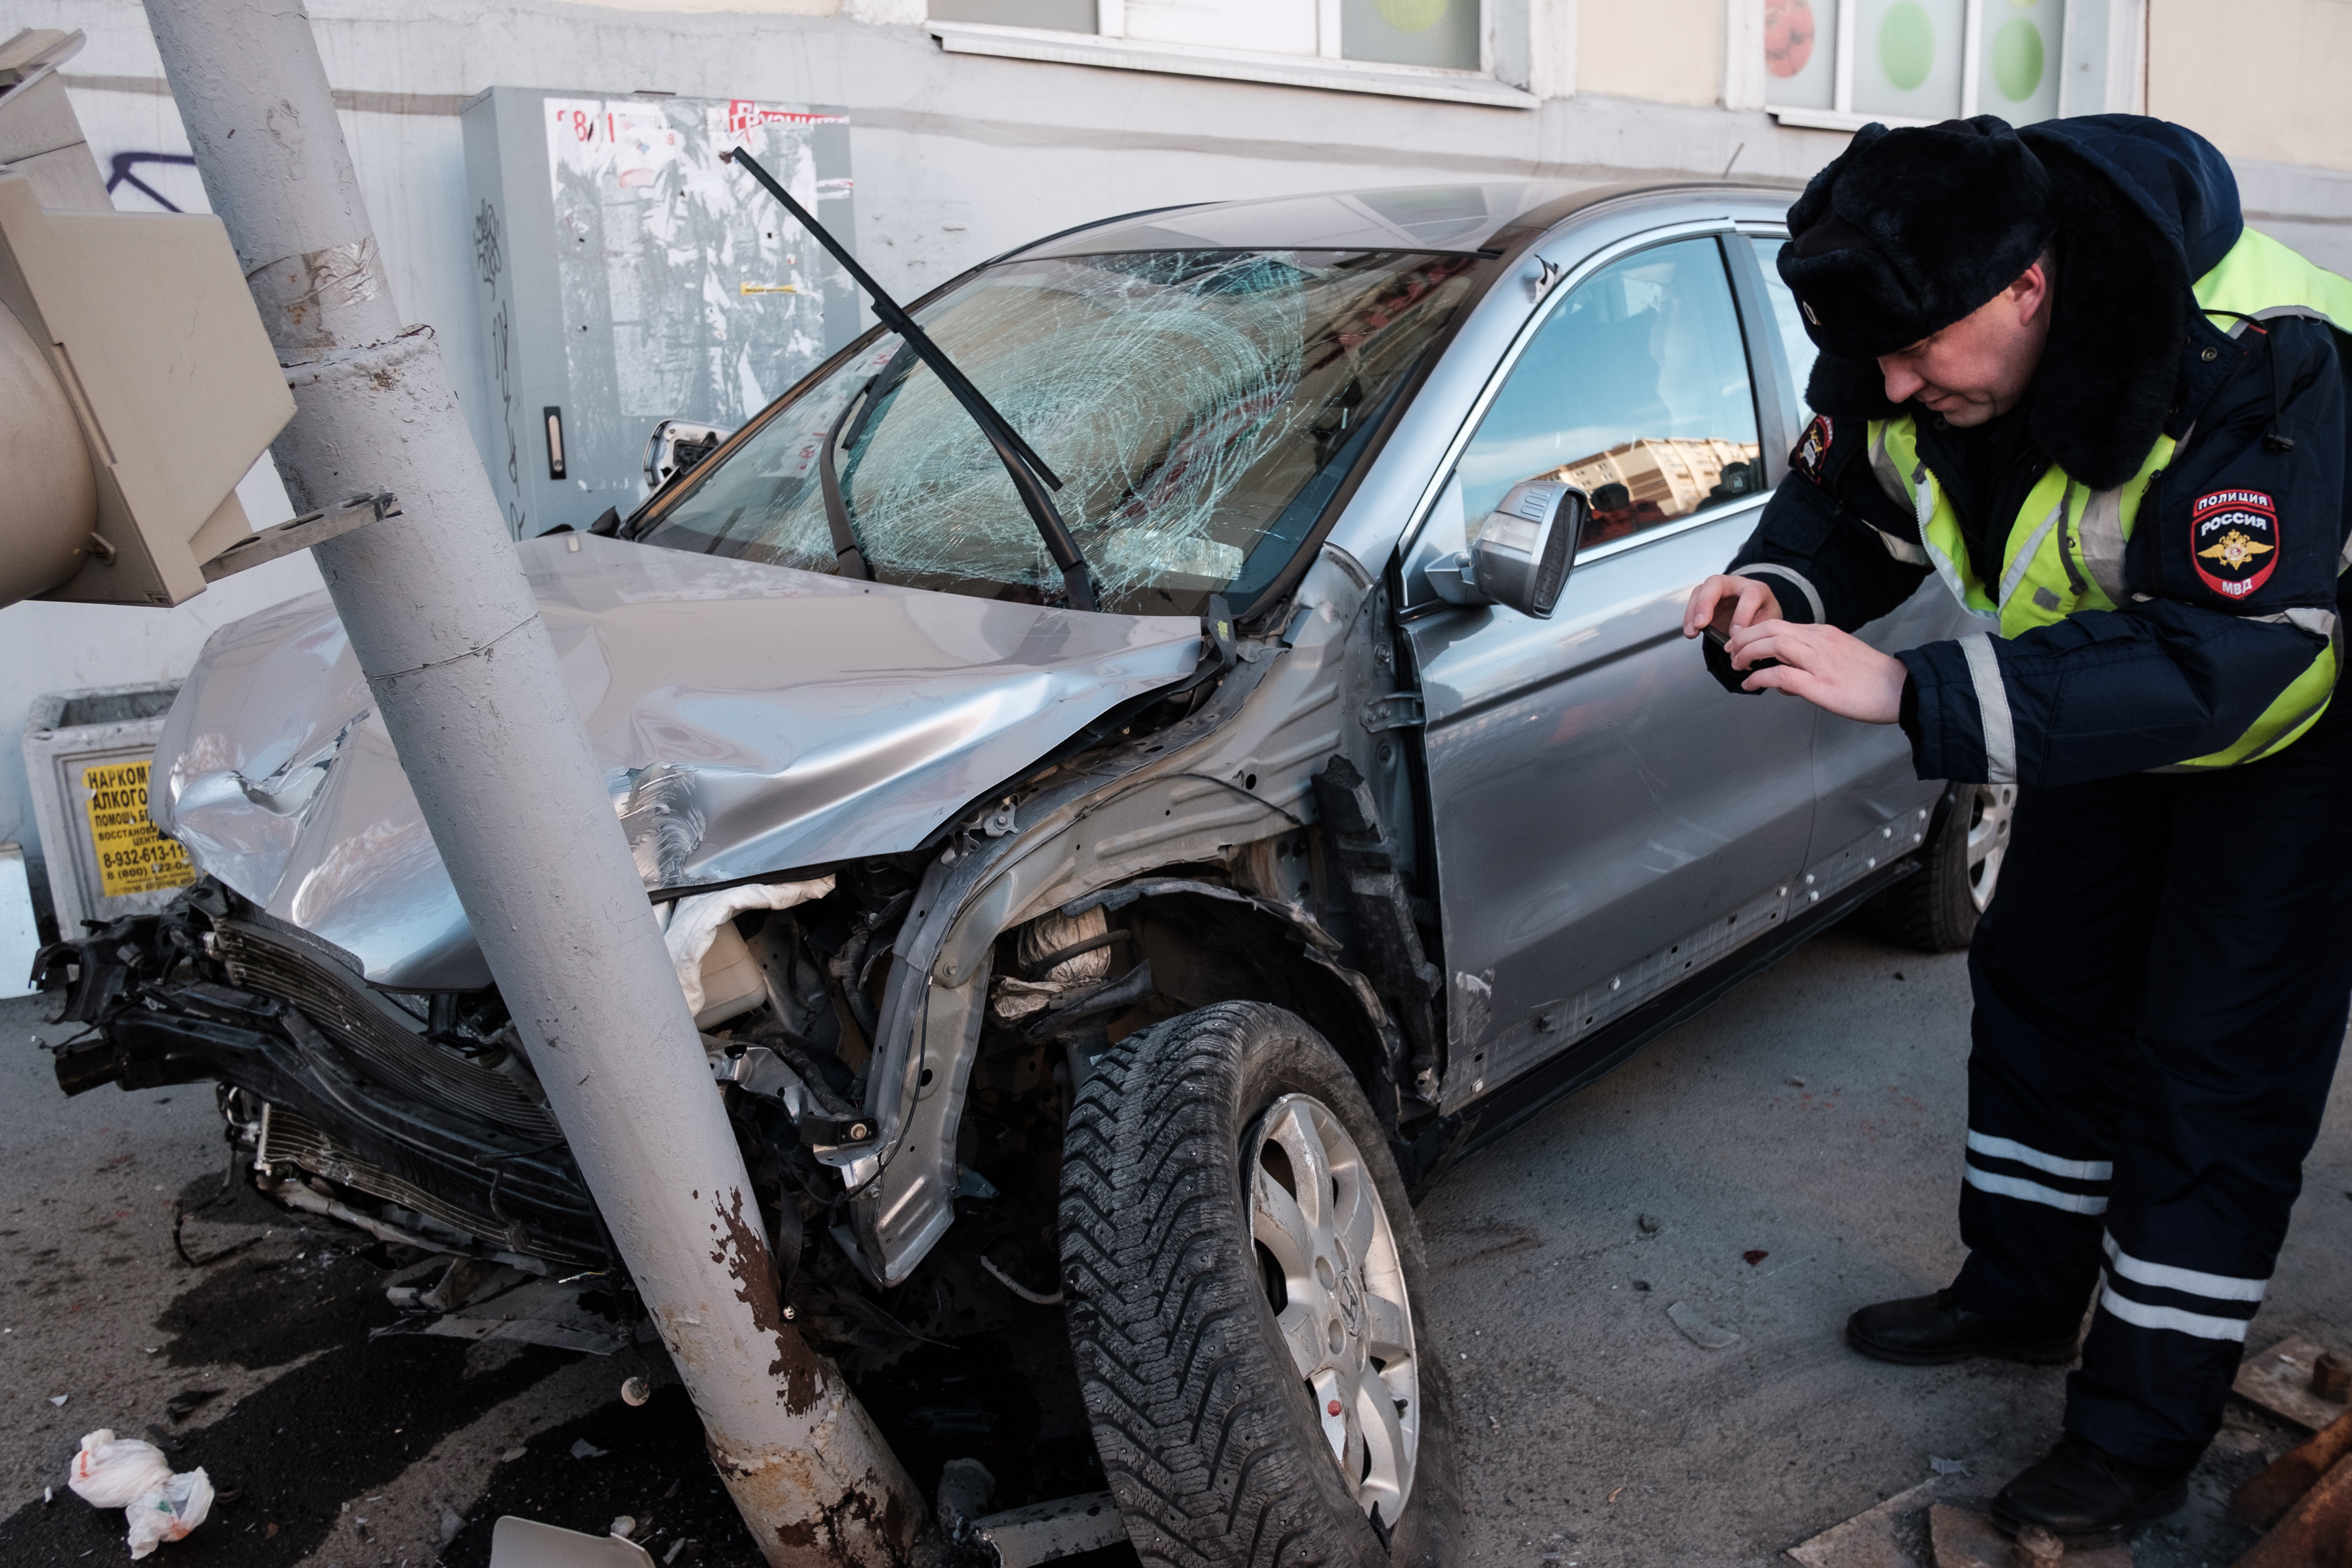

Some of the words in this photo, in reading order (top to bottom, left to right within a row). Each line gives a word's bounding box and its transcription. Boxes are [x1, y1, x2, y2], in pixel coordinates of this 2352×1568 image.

[2198, 492, 2267, 510] ПОЛИЦИЯ
[2201, 513, 2267, 536] РОССИЯ
[2222, 578, 2252, 595] МВД
[88, 766, 151, 790] НАРКОМ
[92, 788, 148, 811] АЛКОГО
